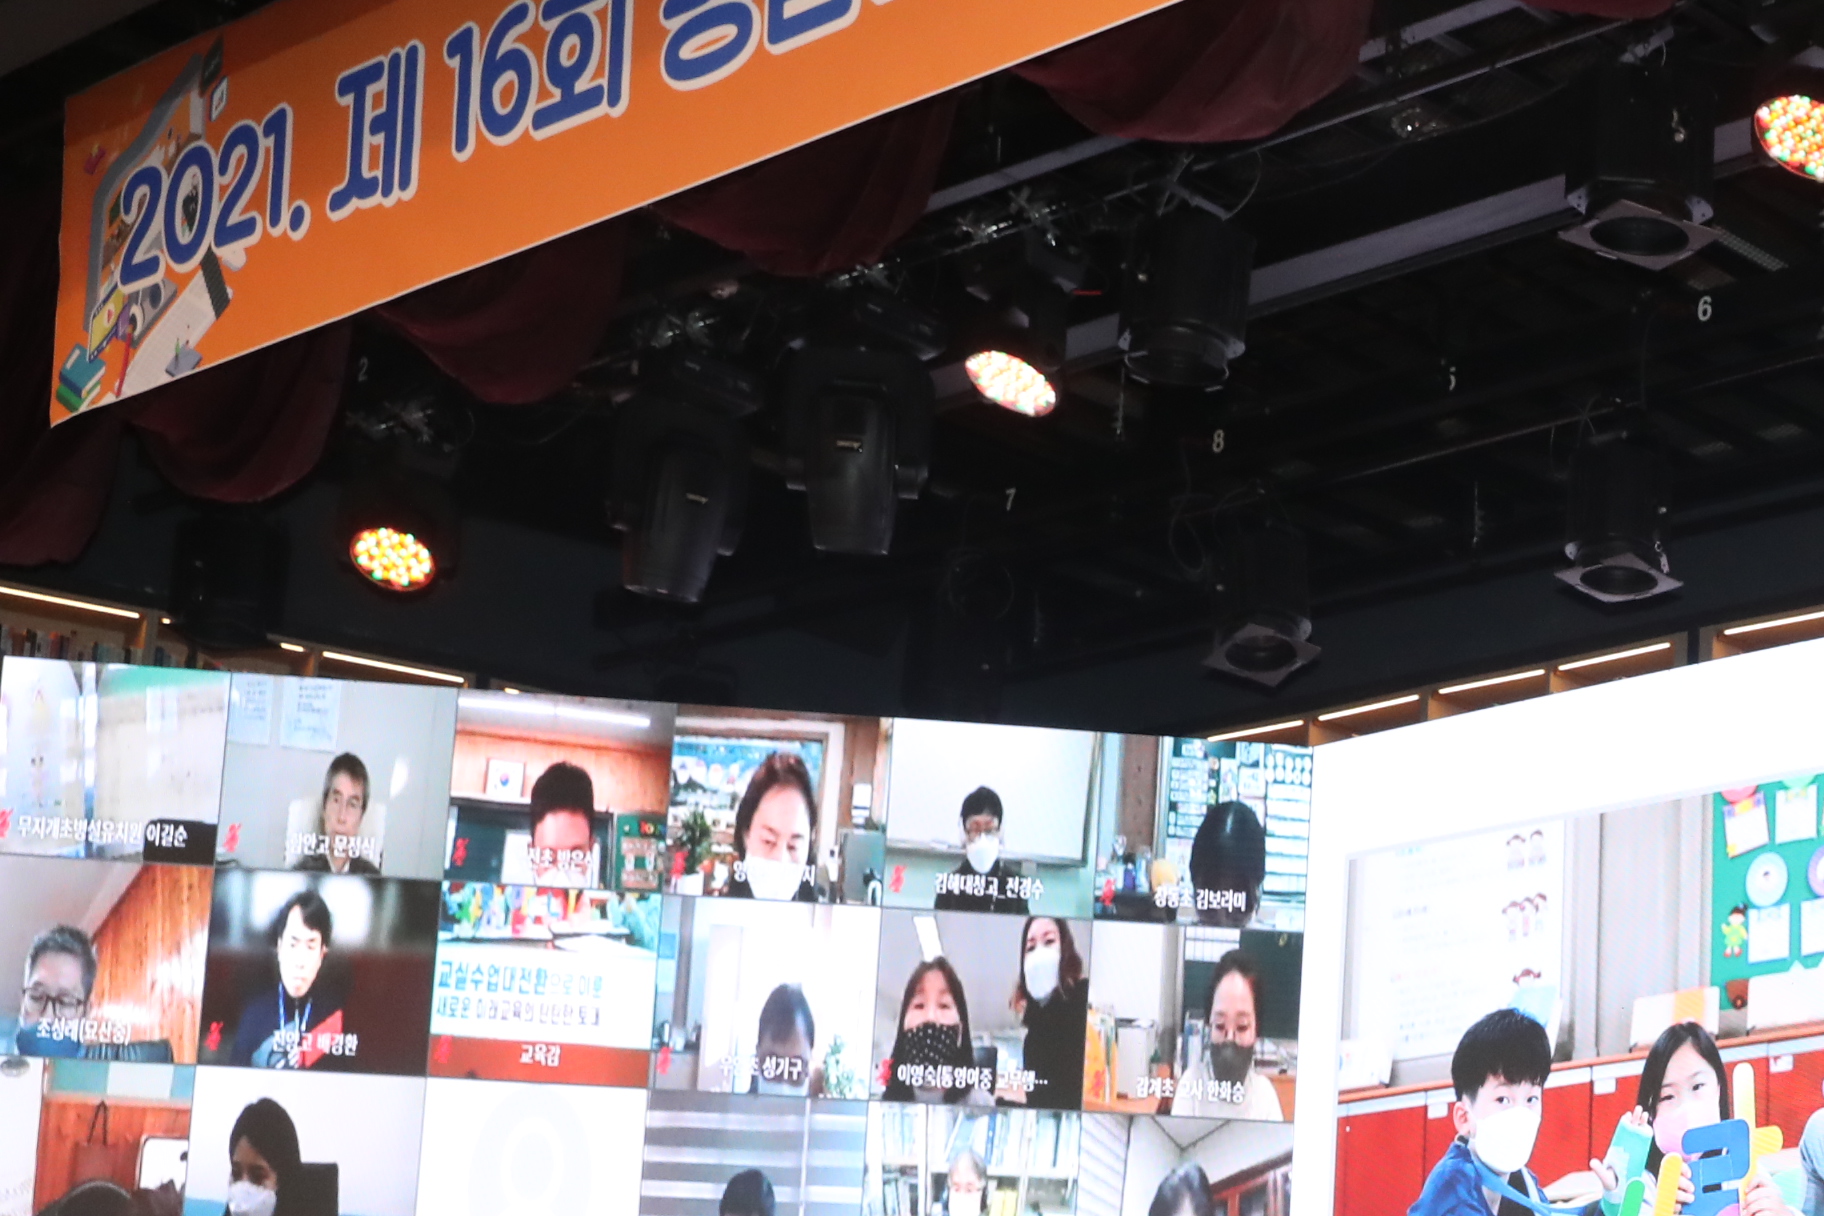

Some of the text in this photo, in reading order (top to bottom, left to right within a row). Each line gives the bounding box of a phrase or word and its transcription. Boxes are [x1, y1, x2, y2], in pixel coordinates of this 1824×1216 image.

[116, 103, 311, 291] 2021.
[327, 40, 425, 219] 제
[444, 0, 631, 161] 16회
[1696, 295, 1713, 323] 6
[1211, 428, 1225, 454] 8
[1196, 887, 1247, 913] 김보라미
[519, 1044, 561, 1068] 교육감
